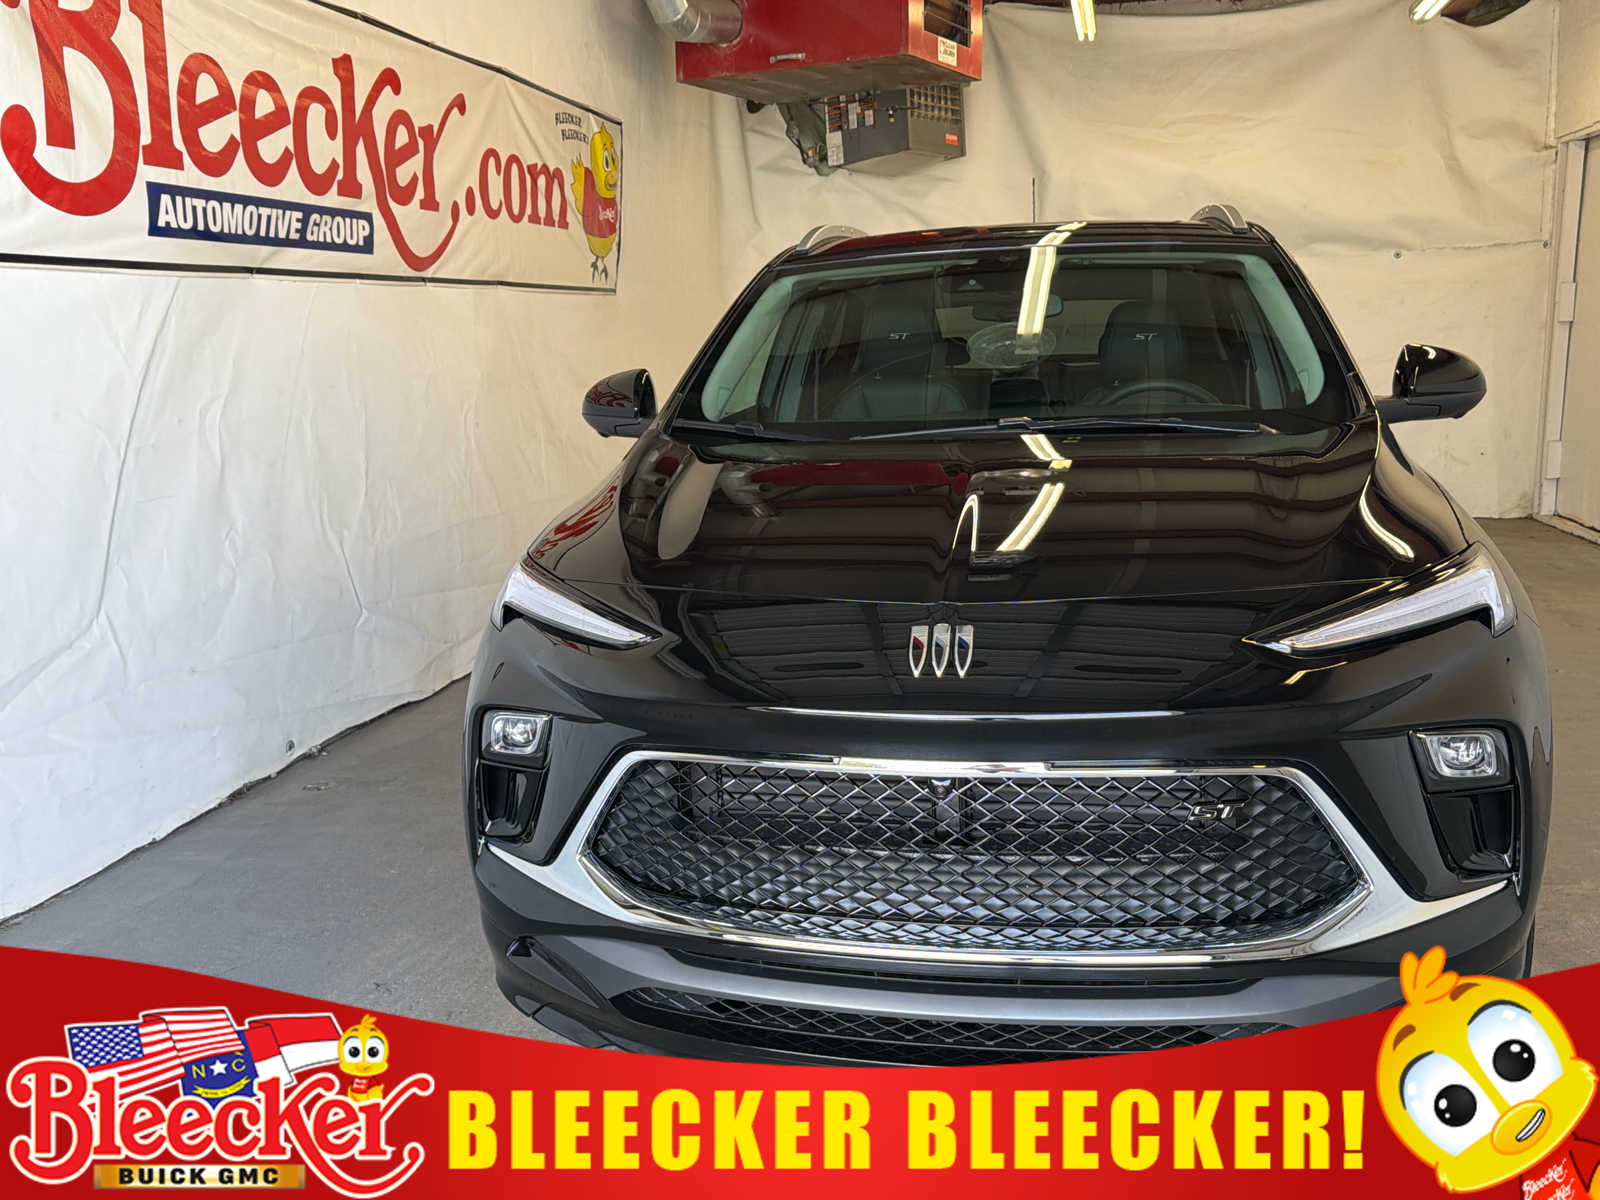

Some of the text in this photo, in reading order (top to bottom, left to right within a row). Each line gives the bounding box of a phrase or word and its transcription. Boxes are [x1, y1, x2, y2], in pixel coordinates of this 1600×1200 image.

[157, 193, 371, 247] AUTOMOTIVE GROUP
[1188, 803, 1245, 820] ST
